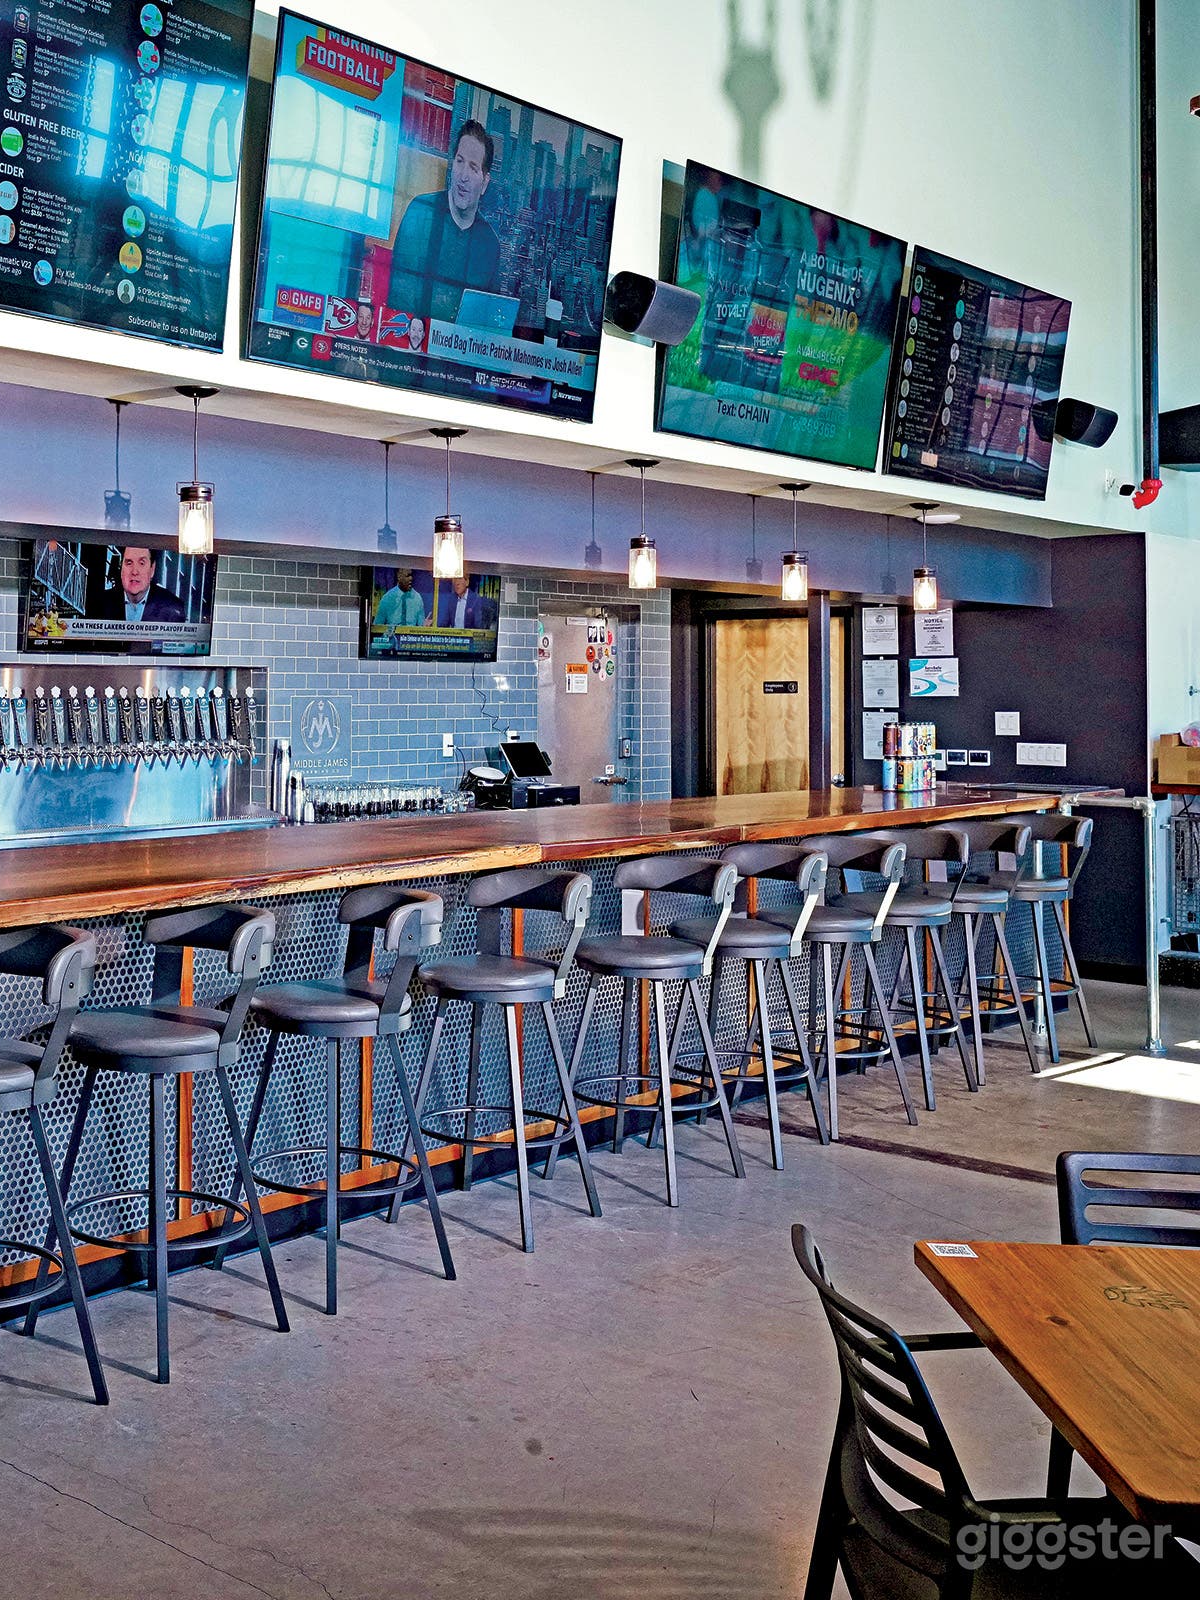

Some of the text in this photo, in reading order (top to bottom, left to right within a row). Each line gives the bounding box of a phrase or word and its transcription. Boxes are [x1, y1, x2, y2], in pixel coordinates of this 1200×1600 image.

[308, 42, 381, 87] FOOTBALL
[3, 108, 84, 140] GLUTEN FREE BEER
[21, 260, 32, 269] V22
[800, 252, 808, 264] A
[11, 268, 22, 276] ago
[56, 267, 76, 279] Fly Kid
[137, 286, 142, 294] 5
[161, 291, 192, 305] Somewhere
[292, 291, 321, 310] GMFB
[795, 294, 859, 336] THERMO
[128, 315, 217, 342] Subscribe to us on Untappd
[334, 342, 368, 354] 49ERS NOTES
[753, 335, 780, 347] THERMO
[432, 329, 583, 377] Mixed Bag Trivia: Patrick Mahomes vs Josh Allen
[797, 345, 834, 364] AVAILABLE
[491, 376, 509, 385] CATCH
[799, 362, 838, 386] GNC
[717, 400, 770, 423] Text: CHAIN
[84, 622, 103, 630] THESE
[104, 623, 126, 631] LAKERS
[160, 625, 184, 633] PLAYOFF
[294, 759, 348, 768] MIDDLE JAMES
